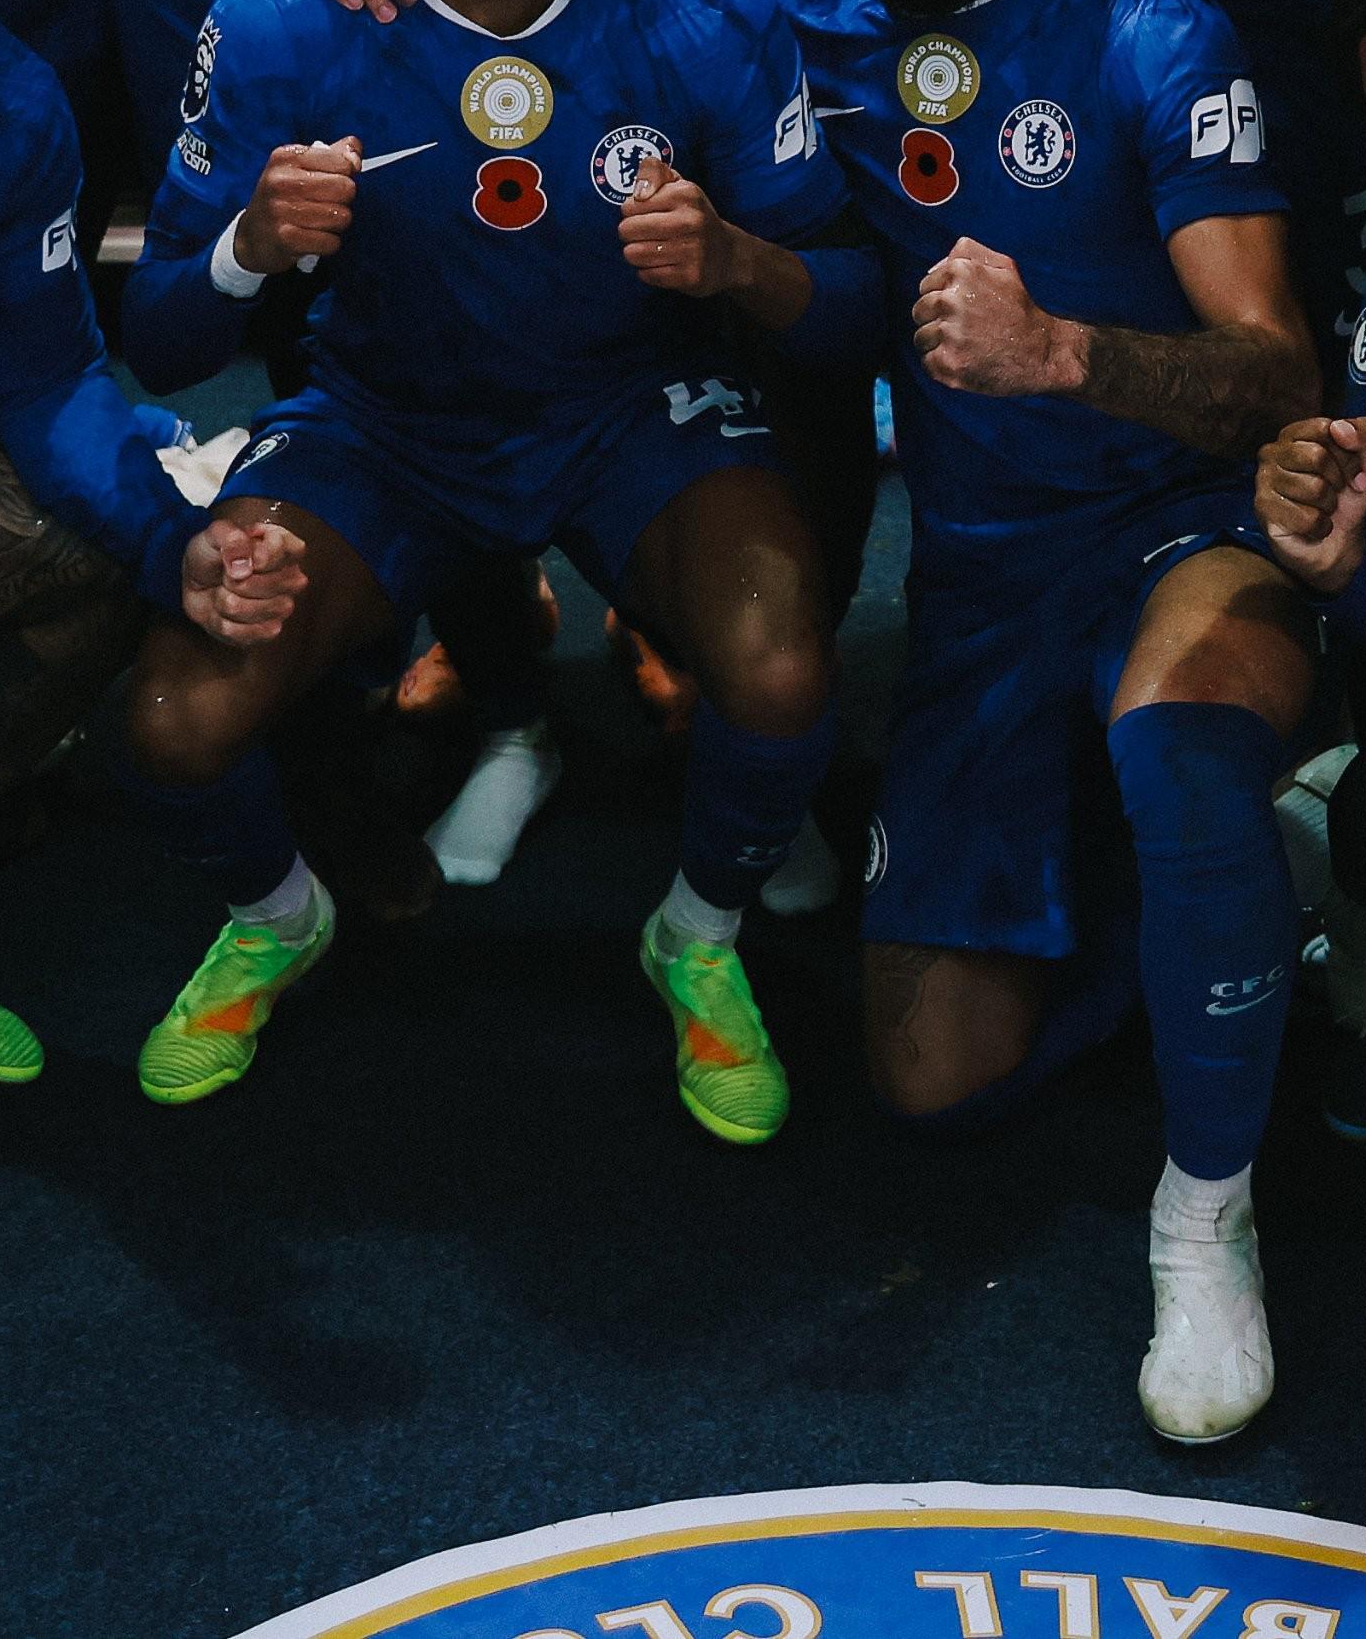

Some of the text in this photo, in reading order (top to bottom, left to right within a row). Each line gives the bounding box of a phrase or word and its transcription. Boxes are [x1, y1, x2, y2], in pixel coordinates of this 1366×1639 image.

[904, 40, 974, 95] WORLD CHAMPIONS
[470, 64, 545, 113] WORLD CHAMPIONS
[917, 100, 948, 117] FIFA
[1014, 102, 1065, 124] CHELSEA
[489, 126, 524, 140] FIFA
[604, 128, 660, 150] CHELSEA
[1210, 964, 1285, 997] CFC
